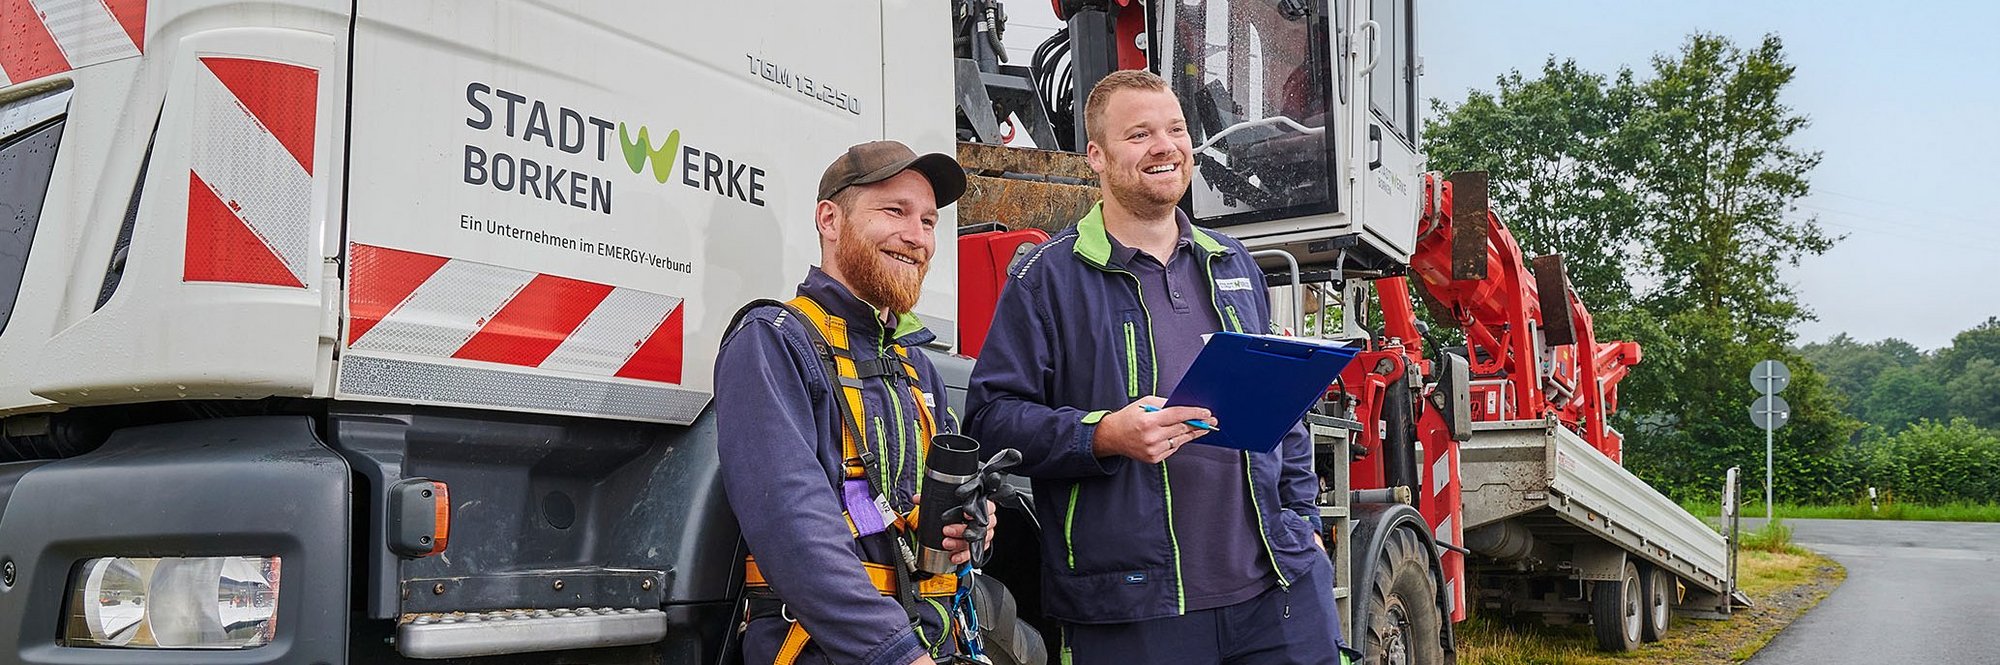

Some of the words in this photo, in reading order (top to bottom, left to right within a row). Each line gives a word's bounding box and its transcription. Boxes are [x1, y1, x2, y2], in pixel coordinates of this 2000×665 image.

[746, 53, 792, 88] TGM
[795, 74, 861, 115] 13.250
[466, 82, 765, 206] STADTWERKE
[228, 199, 242, 213] 3M
[464, 144, 612, 215] BORKEN
[460, 214, 482, 231] Ein
[486, 220, 577, 250] Unternehmen
[580, 238, 594, 254] im
[598, 242, 692, 274] EMERGY-Verbund
[475, 316, 487, 328] 3M
